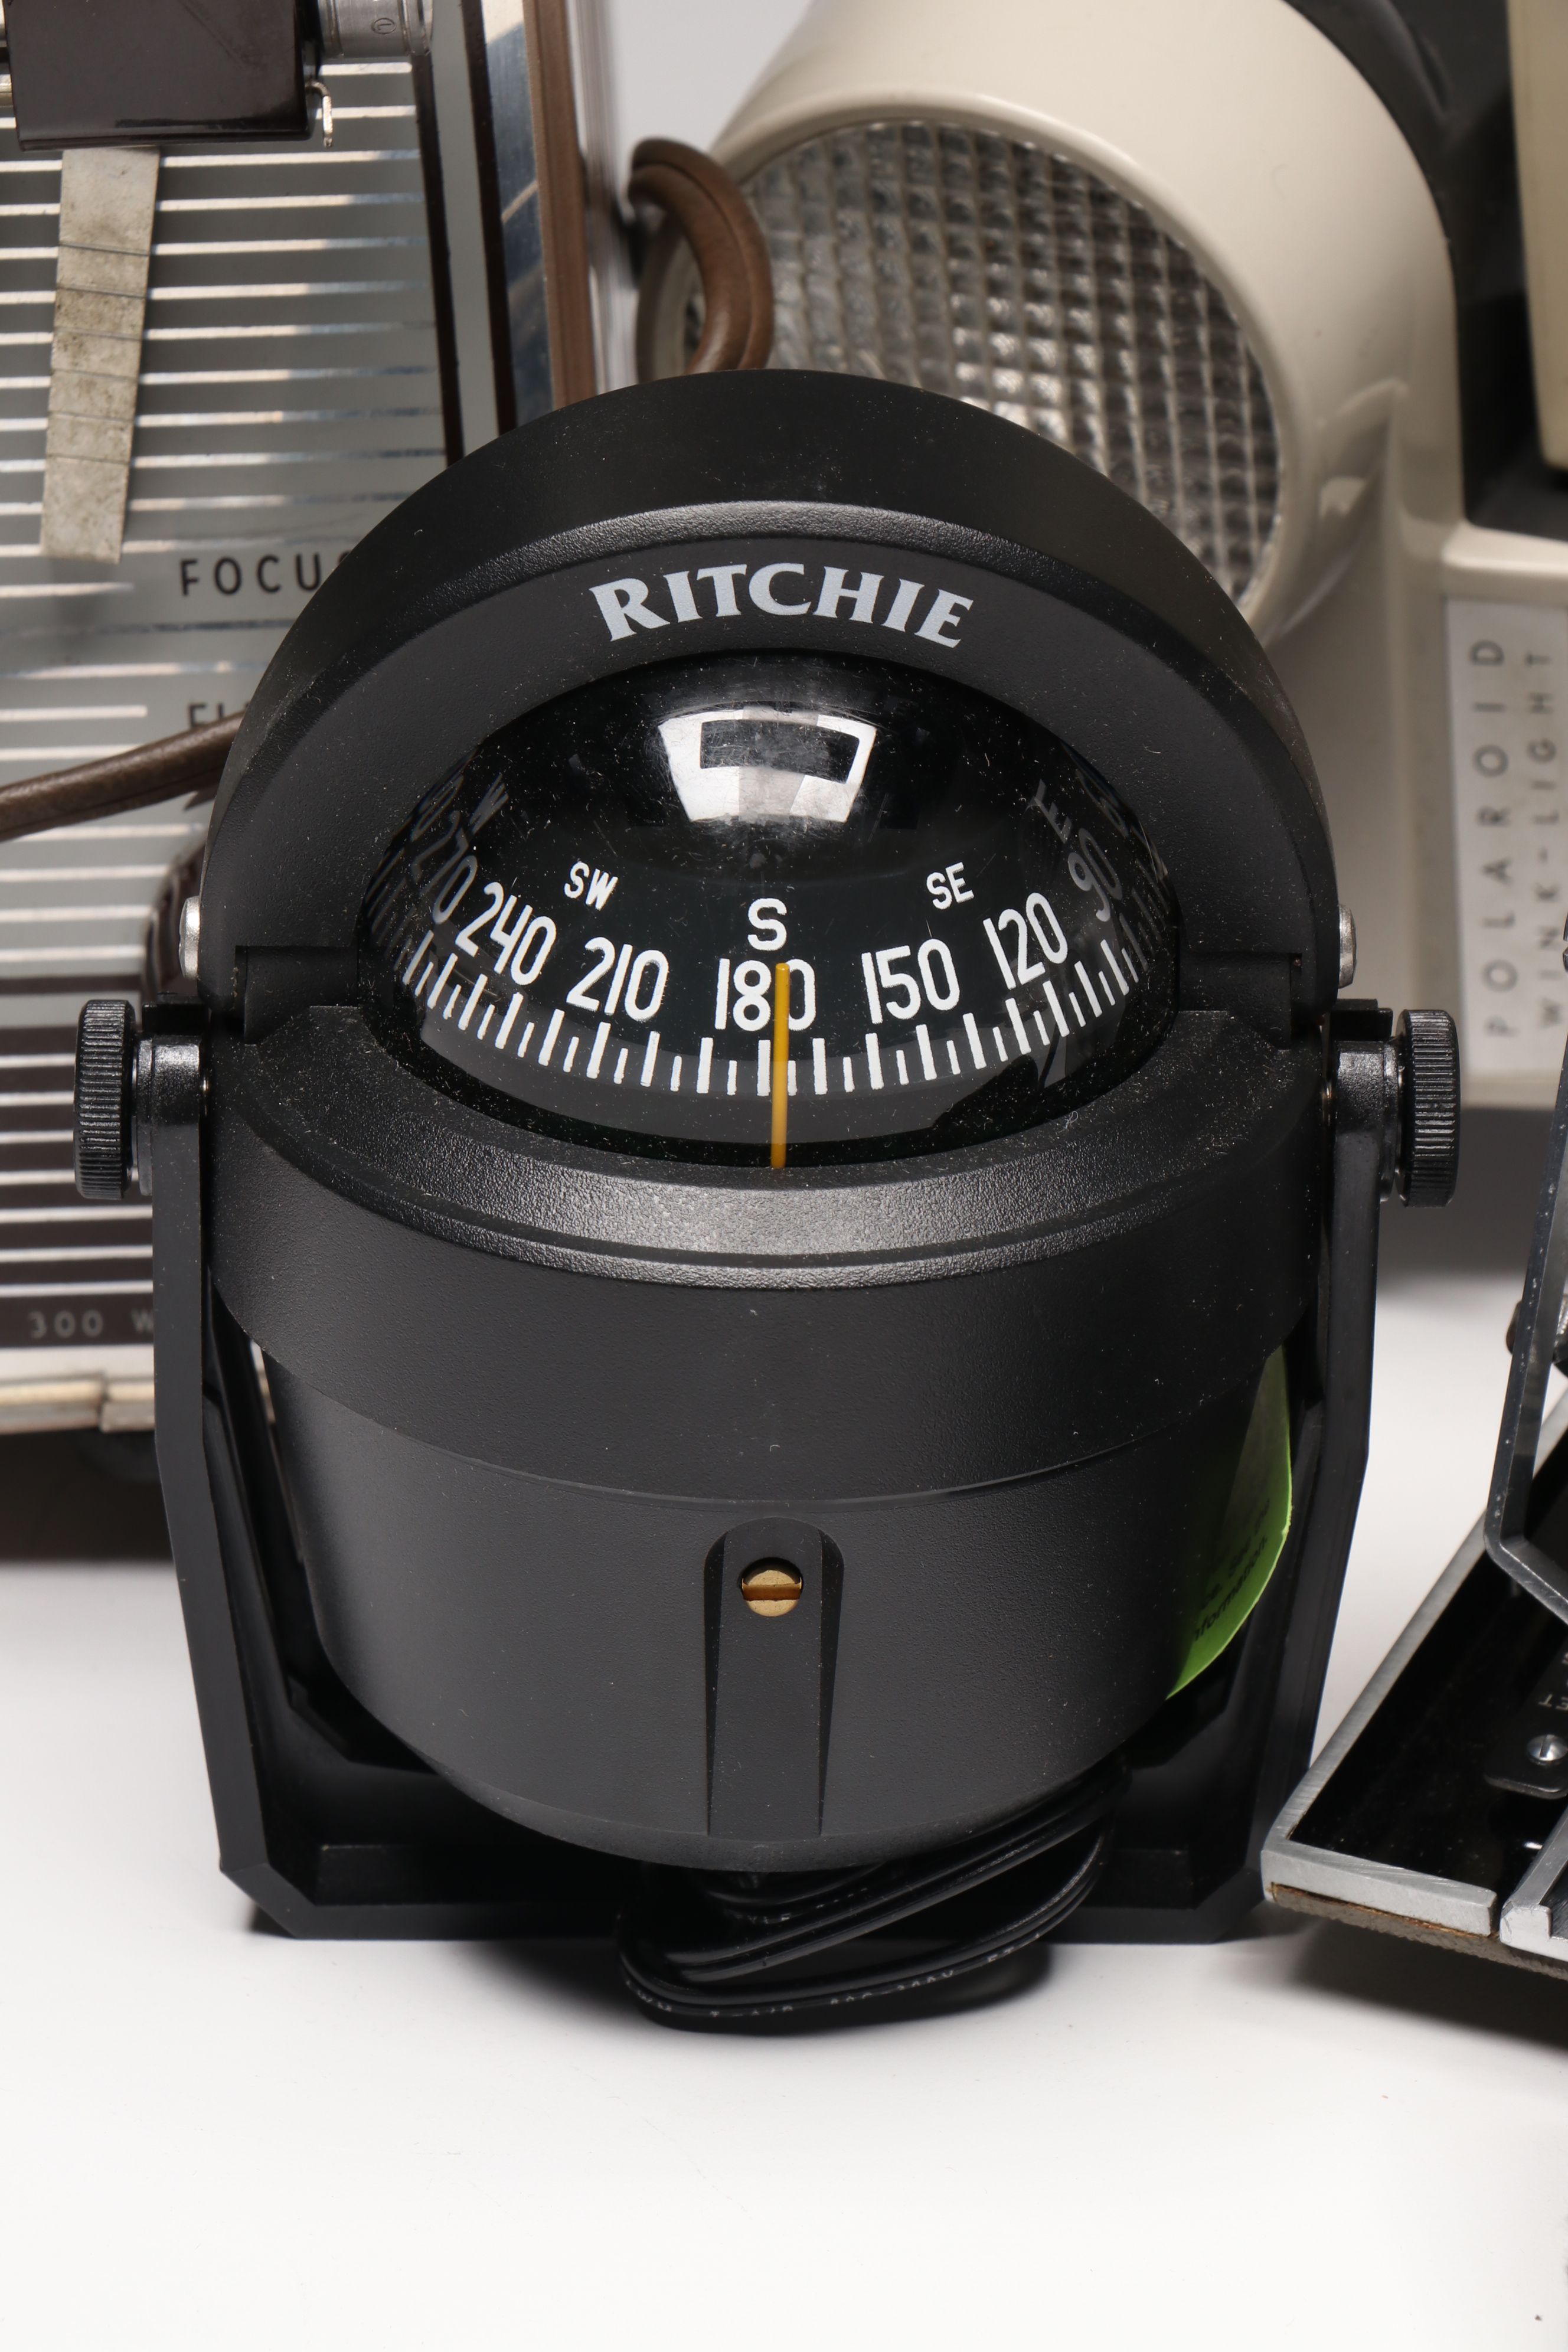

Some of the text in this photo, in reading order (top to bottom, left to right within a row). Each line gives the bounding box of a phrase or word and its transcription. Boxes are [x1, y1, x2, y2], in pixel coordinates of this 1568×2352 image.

[179, 550, 352, 596] FOCU
[589, 563, 974, 648] RITCHIE
[1469, 639, 1518, 1038] POLAROID
[1526, 652, 1563, 1030] WINK-LIGHT
[564, 861, 618, 910] SW
[926, 861, 974, 910] SE
[455, 882, 556, 985] 240
[566, 936, 668, 1022] 210
[714, 958, 816, 1031] 180
[861, 939, 960, 1024] 150
[983, 893, 1067, 991] 120
[1067, 828, 1122, 922] 90
[747, 897, 787, 951] S
[27, 1309, 104, 1340] 300
